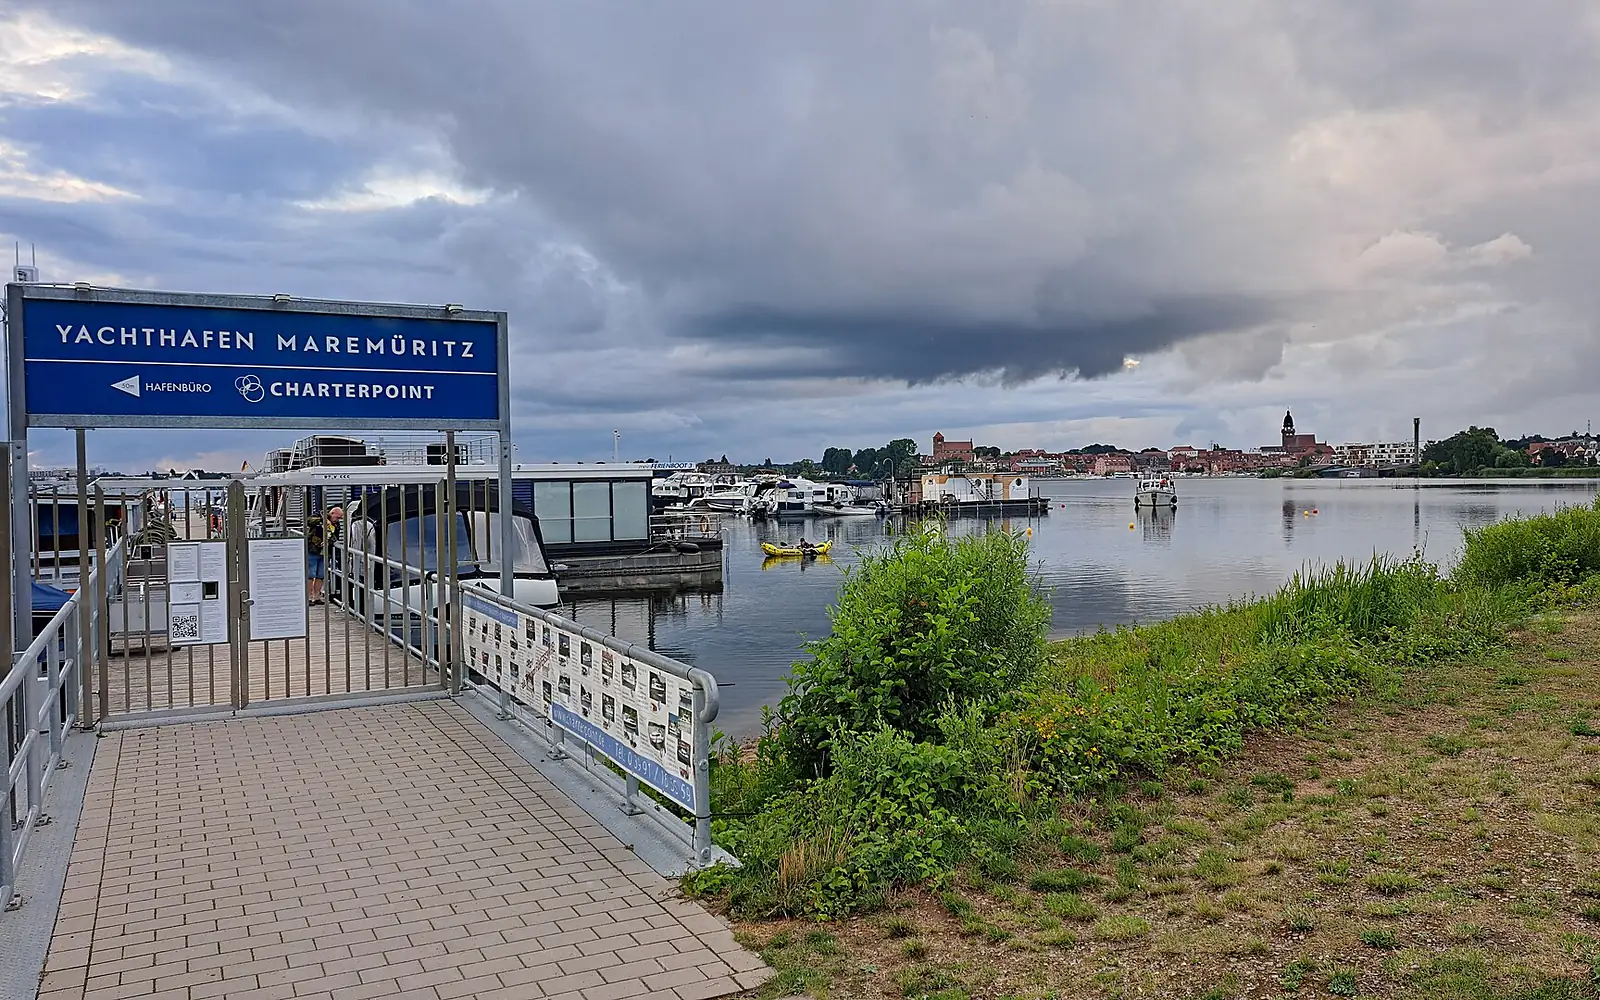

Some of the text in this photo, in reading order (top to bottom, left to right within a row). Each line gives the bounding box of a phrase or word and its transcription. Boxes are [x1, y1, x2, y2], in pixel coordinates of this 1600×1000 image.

[56, 324, 474, 358] YACHTHAFEN MAREMÜRITZ
[145, 382, 212, 393] HAFENBÜRO
[270, 382, 435, 399] CHARTERPOINT
